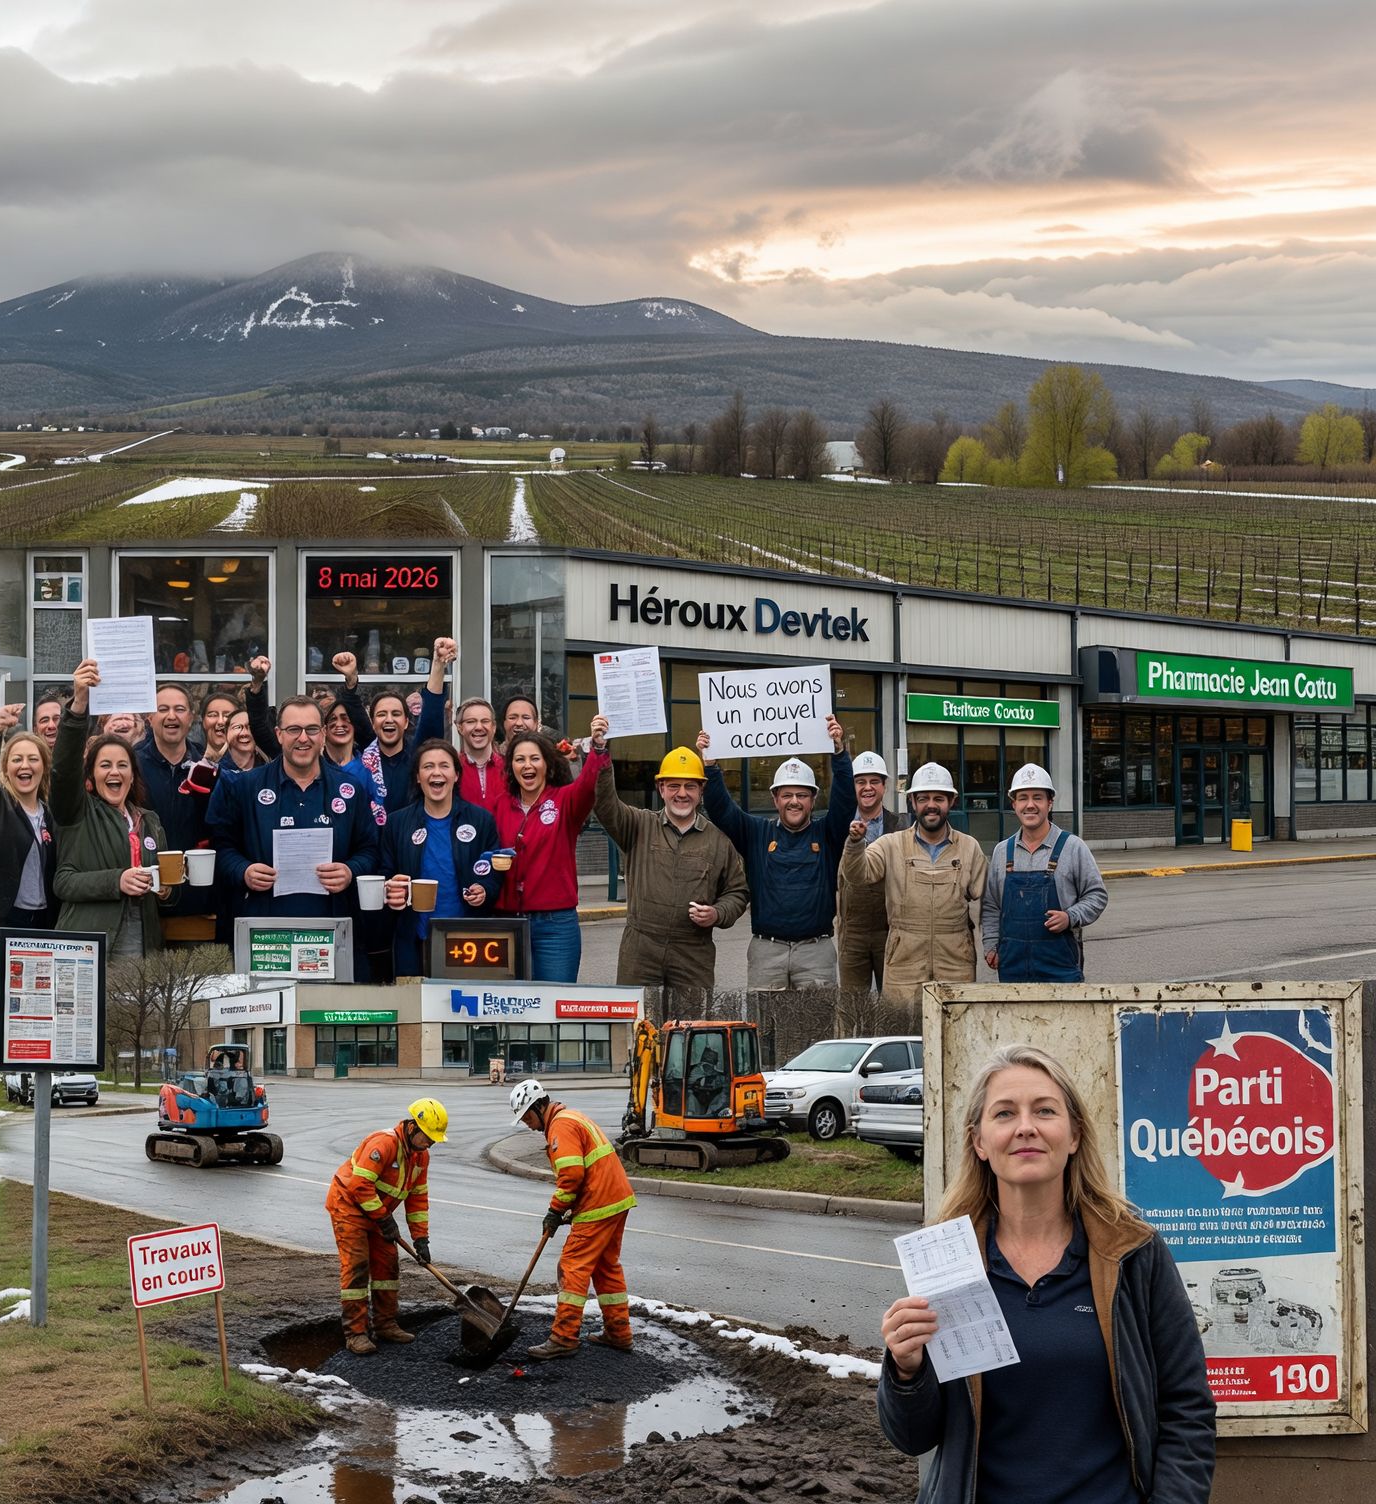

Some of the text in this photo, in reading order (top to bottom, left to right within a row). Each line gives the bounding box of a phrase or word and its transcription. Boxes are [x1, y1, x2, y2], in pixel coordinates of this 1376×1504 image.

[319, 567, 439, 588] 8 mai 2026
[610, 583, 870, 642] Héroux Devtek
[708, 675, 823, 701] Nous avons
[1148, 661, 1245, 694] Pharmacie
[1250, 669, 1290, 697] Jean
[717, 695, 817, 724] un nouvel
[730, 722, 803, 748] accord
[449, 941, 500, 963] +9 C
[1195, 1066, 1283, 1106] Parti
[1129, 1115, 1325, 1163] Québécois
[138, 1240, 212, 1265] Travaux
[141, 1264, 217, 1291] en cours
